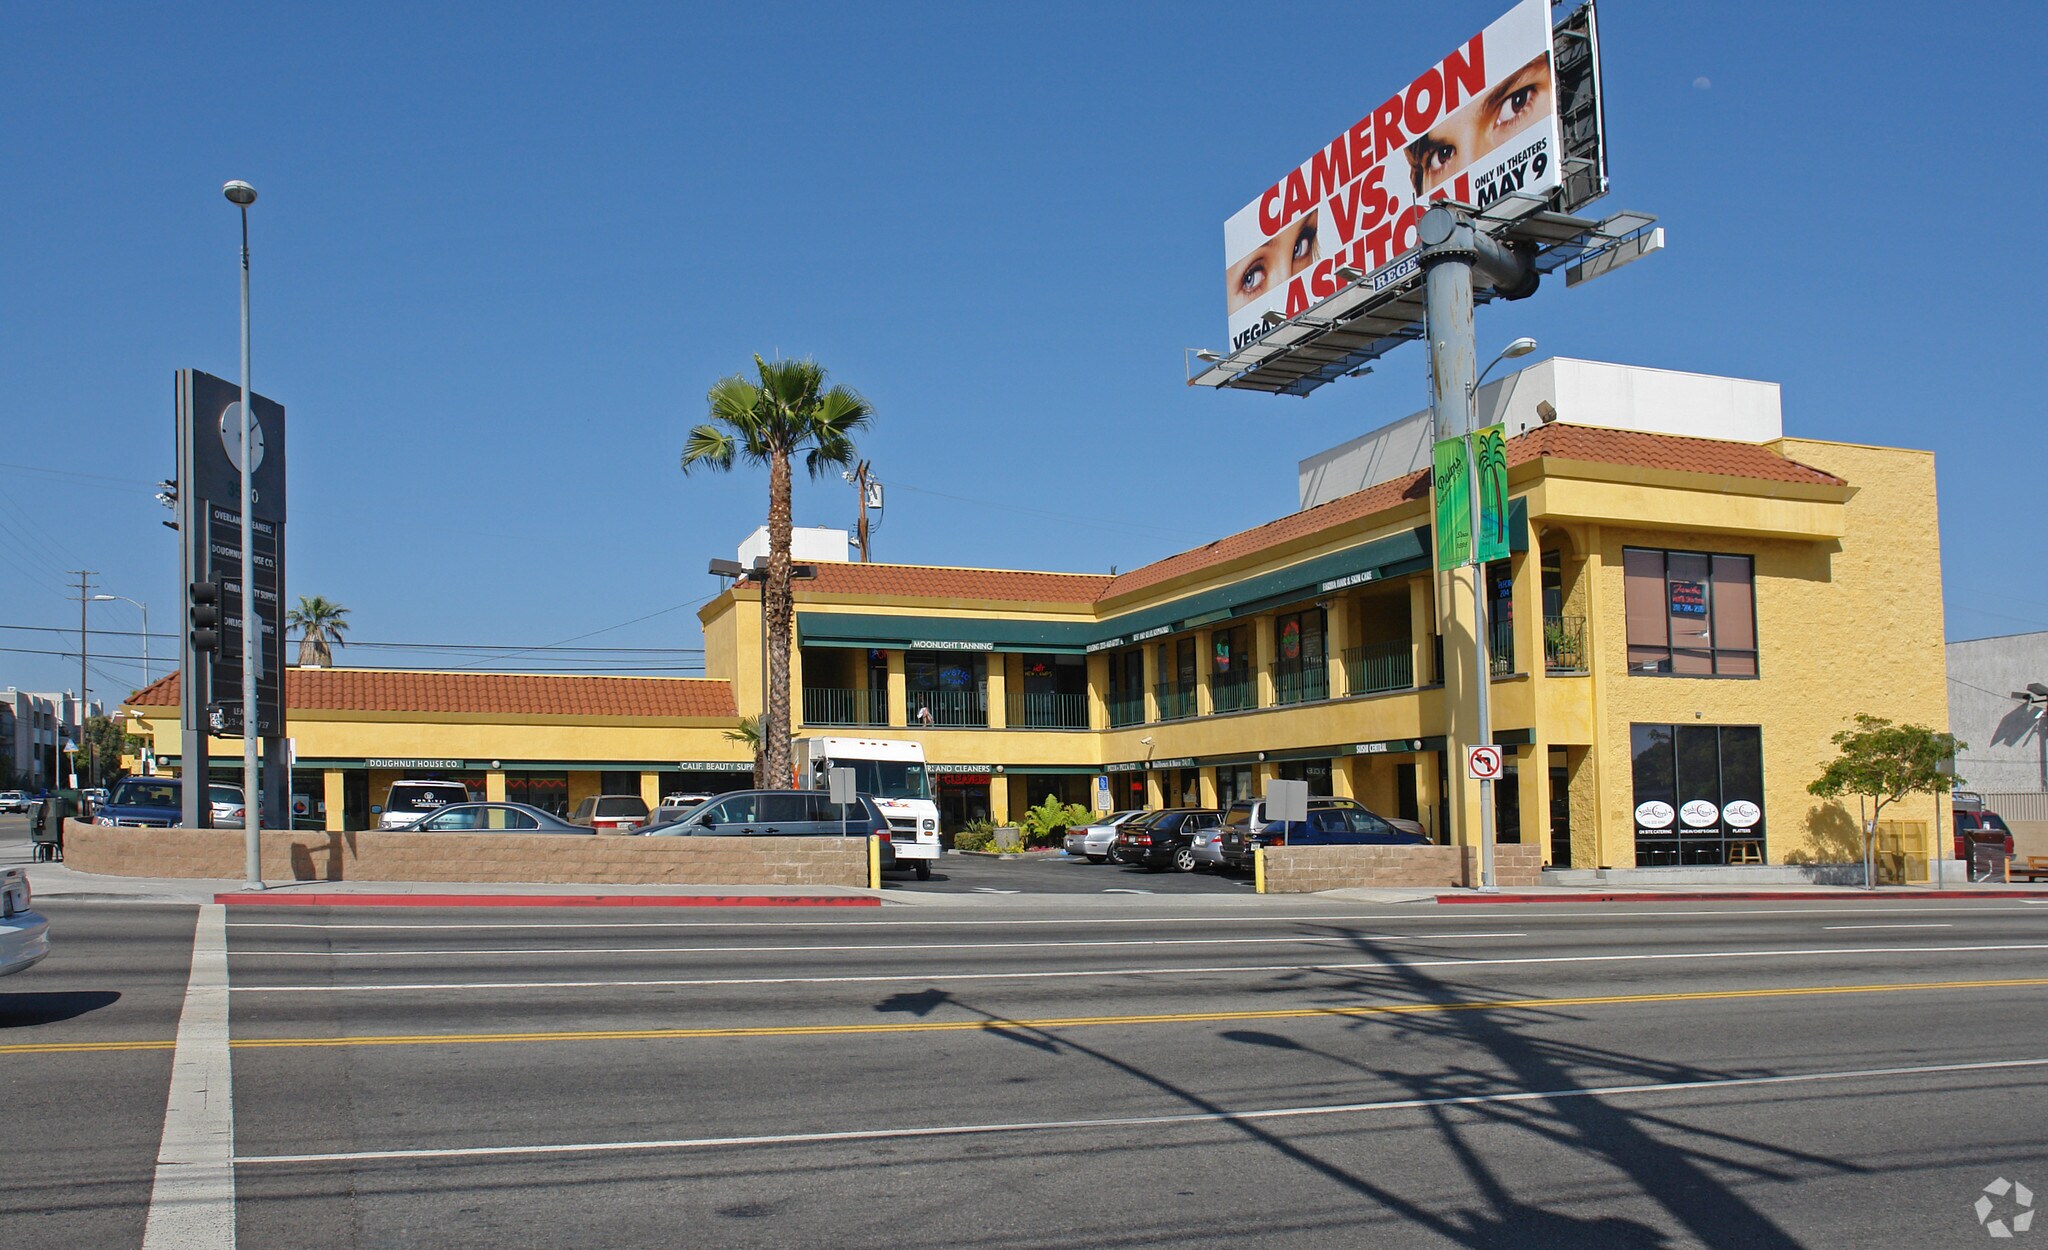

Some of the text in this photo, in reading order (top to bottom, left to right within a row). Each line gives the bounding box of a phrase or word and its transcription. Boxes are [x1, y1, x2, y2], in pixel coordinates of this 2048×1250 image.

[1258, 30, 1487, 237] CAMERON
[1474, 137, 1547, 189] ONLY IN THEATERS
[1477, 152, 1548, 209] MAY 9
[1328, 165, 1399, 246] VS.
[1375, 252, 1422, 291] REGE
[1232, 318, 1278, 351] VEGA
[214, 510, 272, 534] OVERLAN EANERS
[211, 544, 243, 559] DOUGHNU
[253, 556, 264, 566] USE
[913, 641, 993, 650] MOONLIGHT TANNING
[370, 760, 460, 768] DOUGHNUT HOUSE CO.
[681, 762, 754, 771] CALIF. BEAUTY SUPP
[954, 764, 991, 773] CLEANERS
